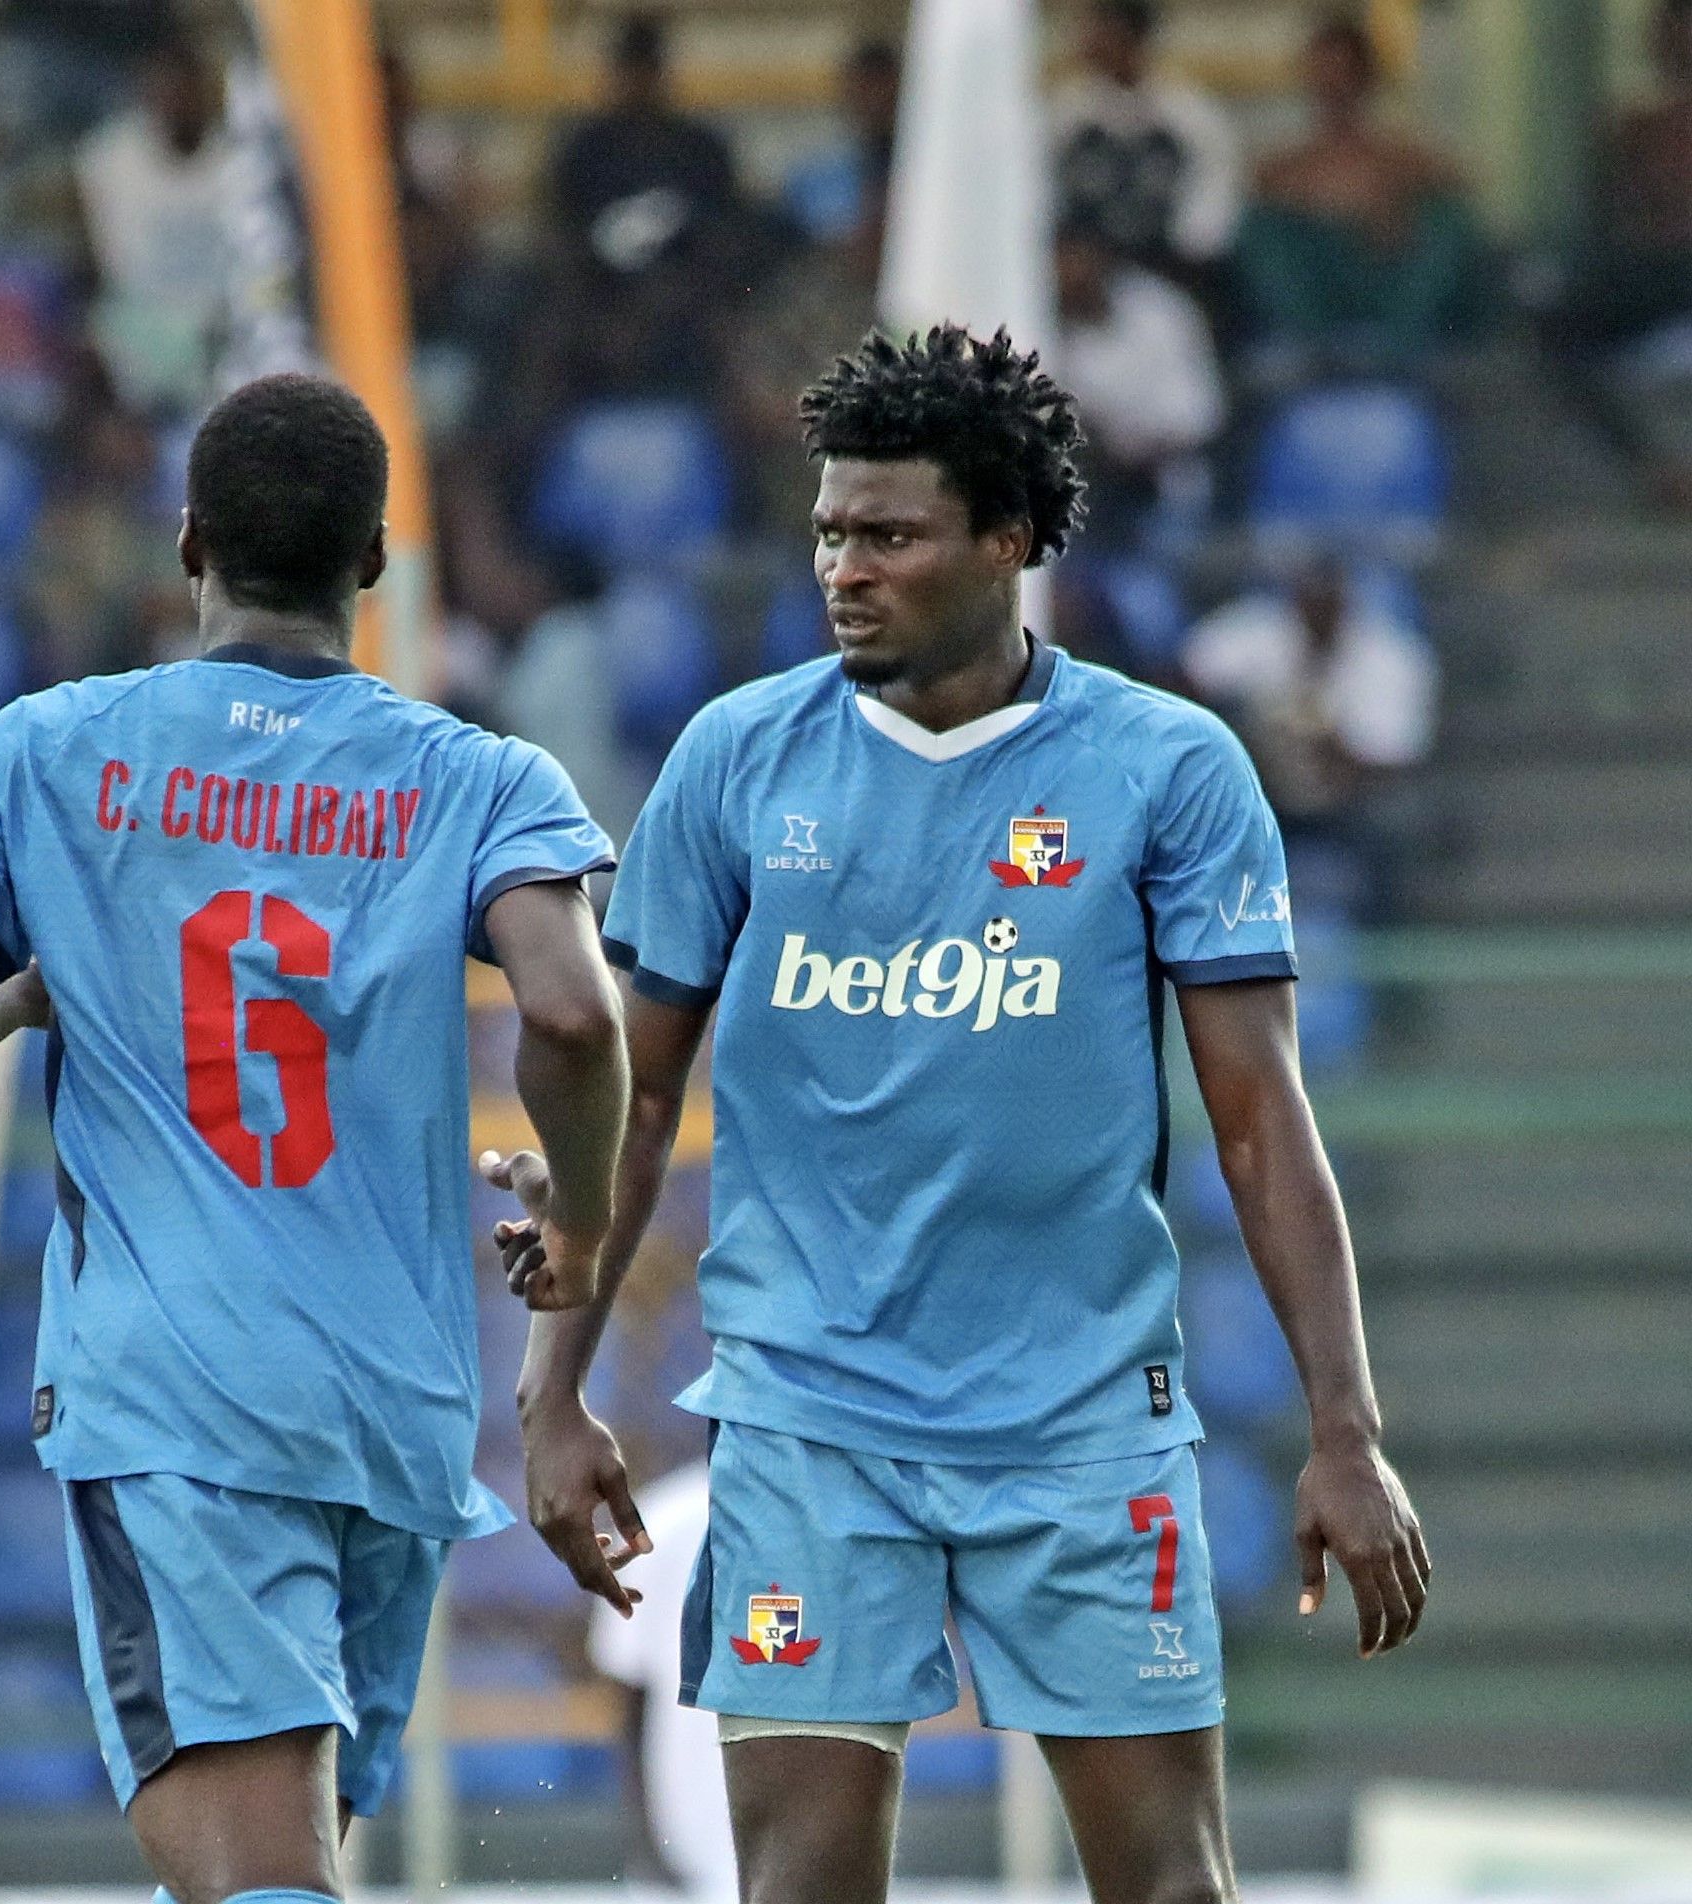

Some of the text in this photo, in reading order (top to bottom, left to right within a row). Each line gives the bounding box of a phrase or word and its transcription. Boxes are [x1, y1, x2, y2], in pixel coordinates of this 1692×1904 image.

[96, 759, 422, 860] C. COULIBALY
[765, 855, 834, 873] DEXIE
[1030, 850, 1046, 862] 33
[769, 917, 1061, 1032] bet9ja
[179, 889, 336, 1189] 6
[1126, 1493, 1180, 1613] 7
[765, 1627, 781, 1640] 33
[1138, 1662, 1201, 1680] DEXIE
